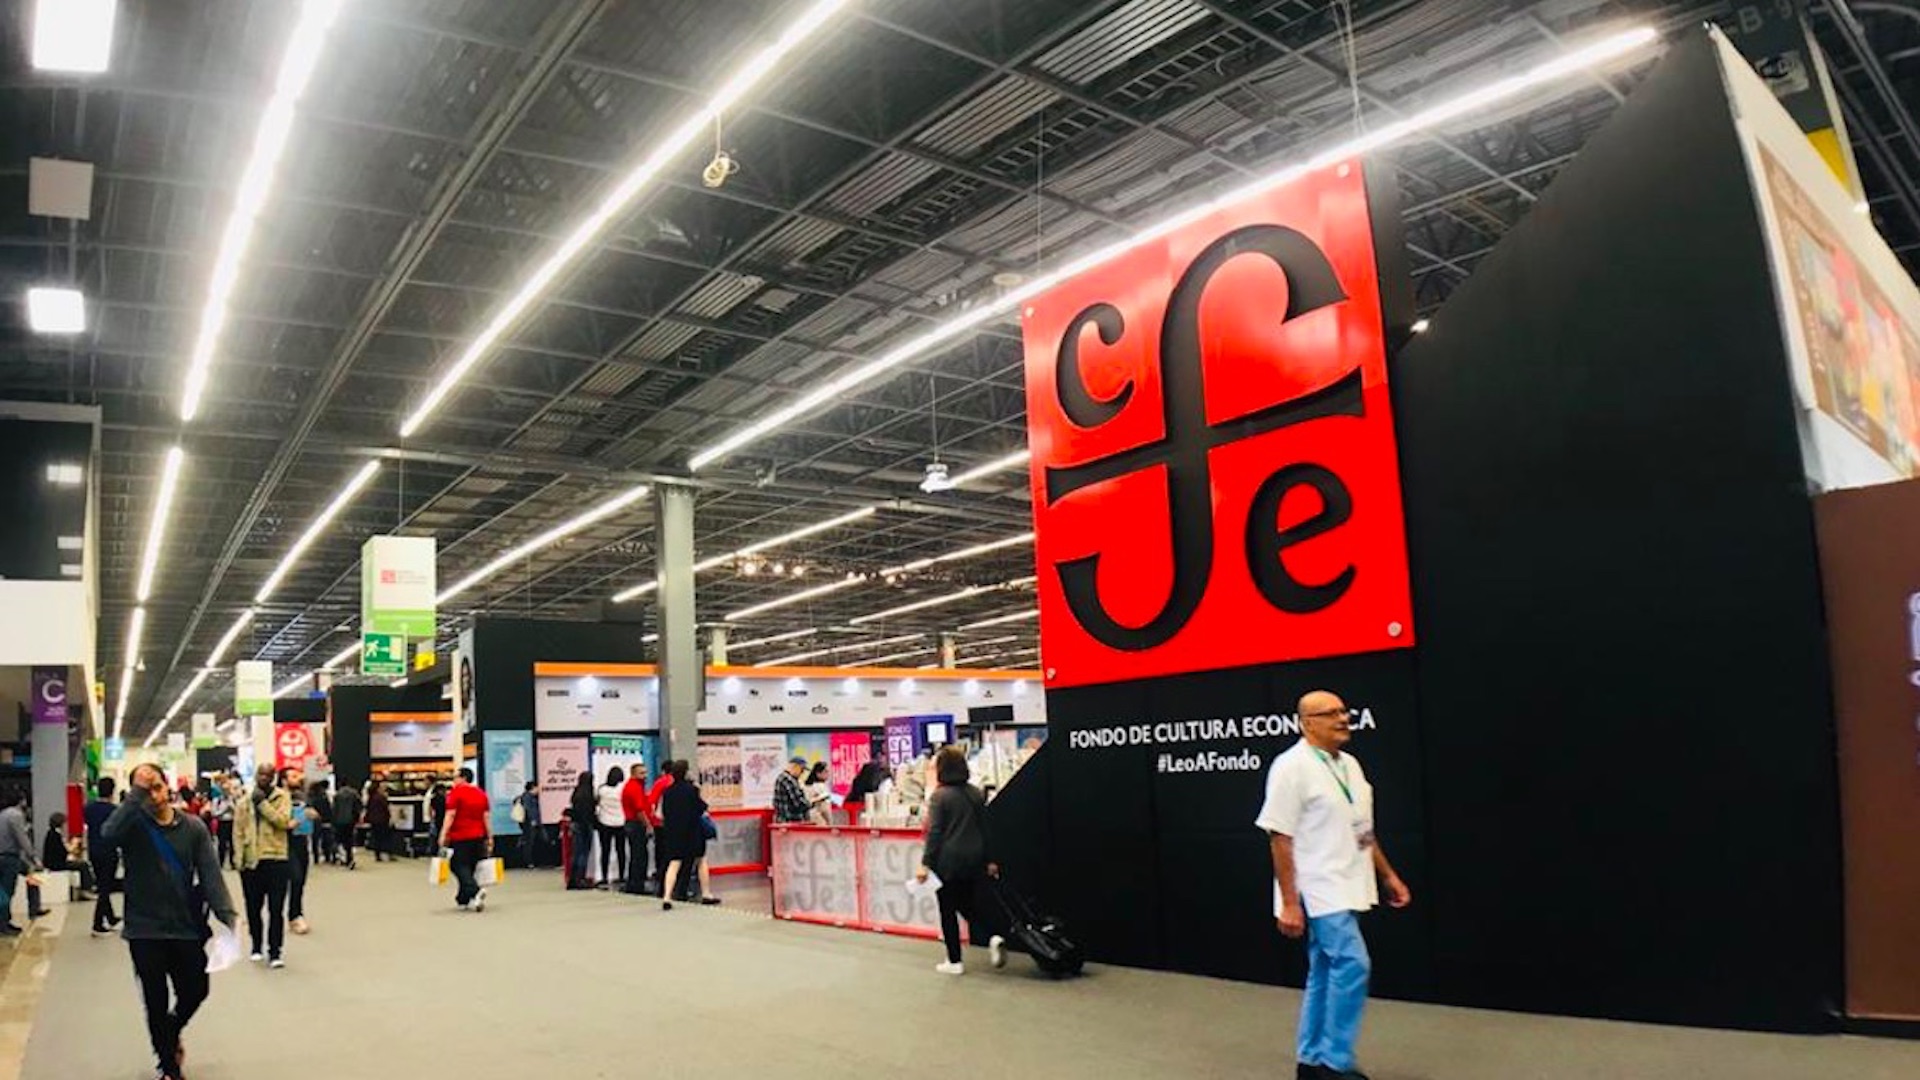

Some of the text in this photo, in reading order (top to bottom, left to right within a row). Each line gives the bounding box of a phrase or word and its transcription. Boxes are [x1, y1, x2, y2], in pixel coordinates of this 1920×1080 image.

[42, 680, 66, 704] C
[1070, 726, 1127, 749] FONDO
[1129, 724, 1152, 745] DE
[1154, 718, 1240, 743] CULTURA
[1157, 748, 1261, 773] #LeoAFondo
